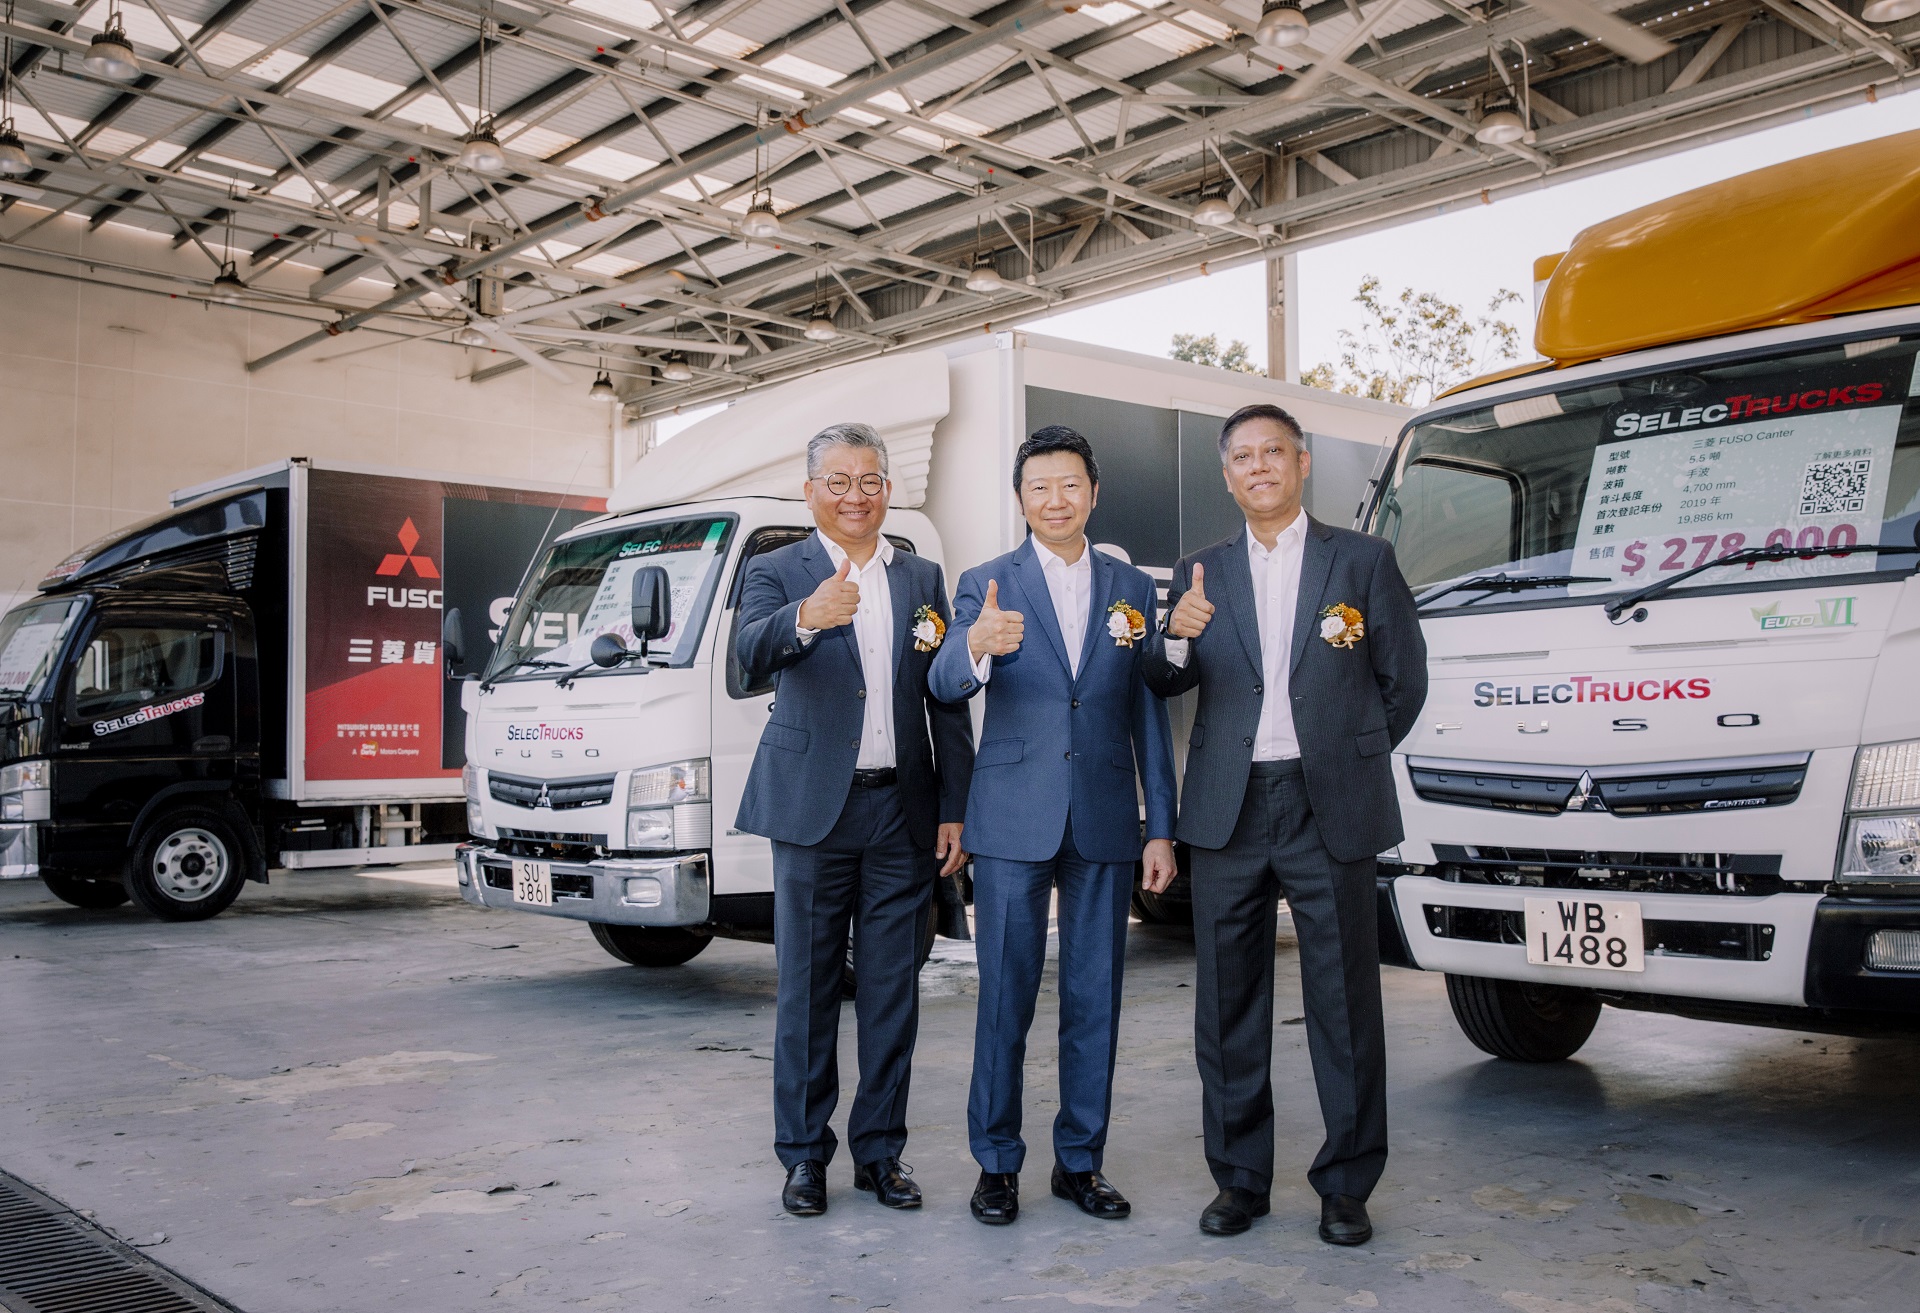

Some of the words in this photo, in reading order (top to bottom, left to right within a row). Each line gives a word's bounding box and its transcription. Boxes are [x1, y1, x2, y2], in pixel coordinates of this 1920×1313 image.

[1613, 382, 1884, 438] SELECTRUCKS
[1608, 450, 1631, 462] 型號
[1692, 437, 1715, 449] 三菱
[1719, 433, 1754, 445] FUSO
[1756, 429, 1795, 441] Canter
[1605, 464, 1628, 475] 噸數
[1689, 454, 1706, 464] 5.5
[1602, 478, 1625, 490] 波箱
[1686, 467, 1710, 479] 手波
[1599, 490, 1643, 505] 貨斗長度
[1682, 482, 1713, 494] 4,700
[1715, 481, 1737, 490] mm
[1596, 502, 1663, 520] 首次登記年份
[1680, 498, 1707, 509] 2019
[1710, 496, 1721, 506] 年
[1592, 523, 1616, 535] 里數
[1677, 513, 1714, 525] 19,886
[1717, 512, 1734, 520] km
[1589, 546, 1616, 560] 售價
[1763, 615, 1815, 629] EURO
[1473, 675, 1711, 708] SELECTRUCKS
[93, 694, 204, 735] SELECTRUCKS
[507, 723, 584, 741] SELECTRUCKS
[523, 863, 540, 883] SU
[518, 881, 548, 904] 3861
[1557, 901, 1606, 933] WB
[1542, 932, 1628, 968] 1488
